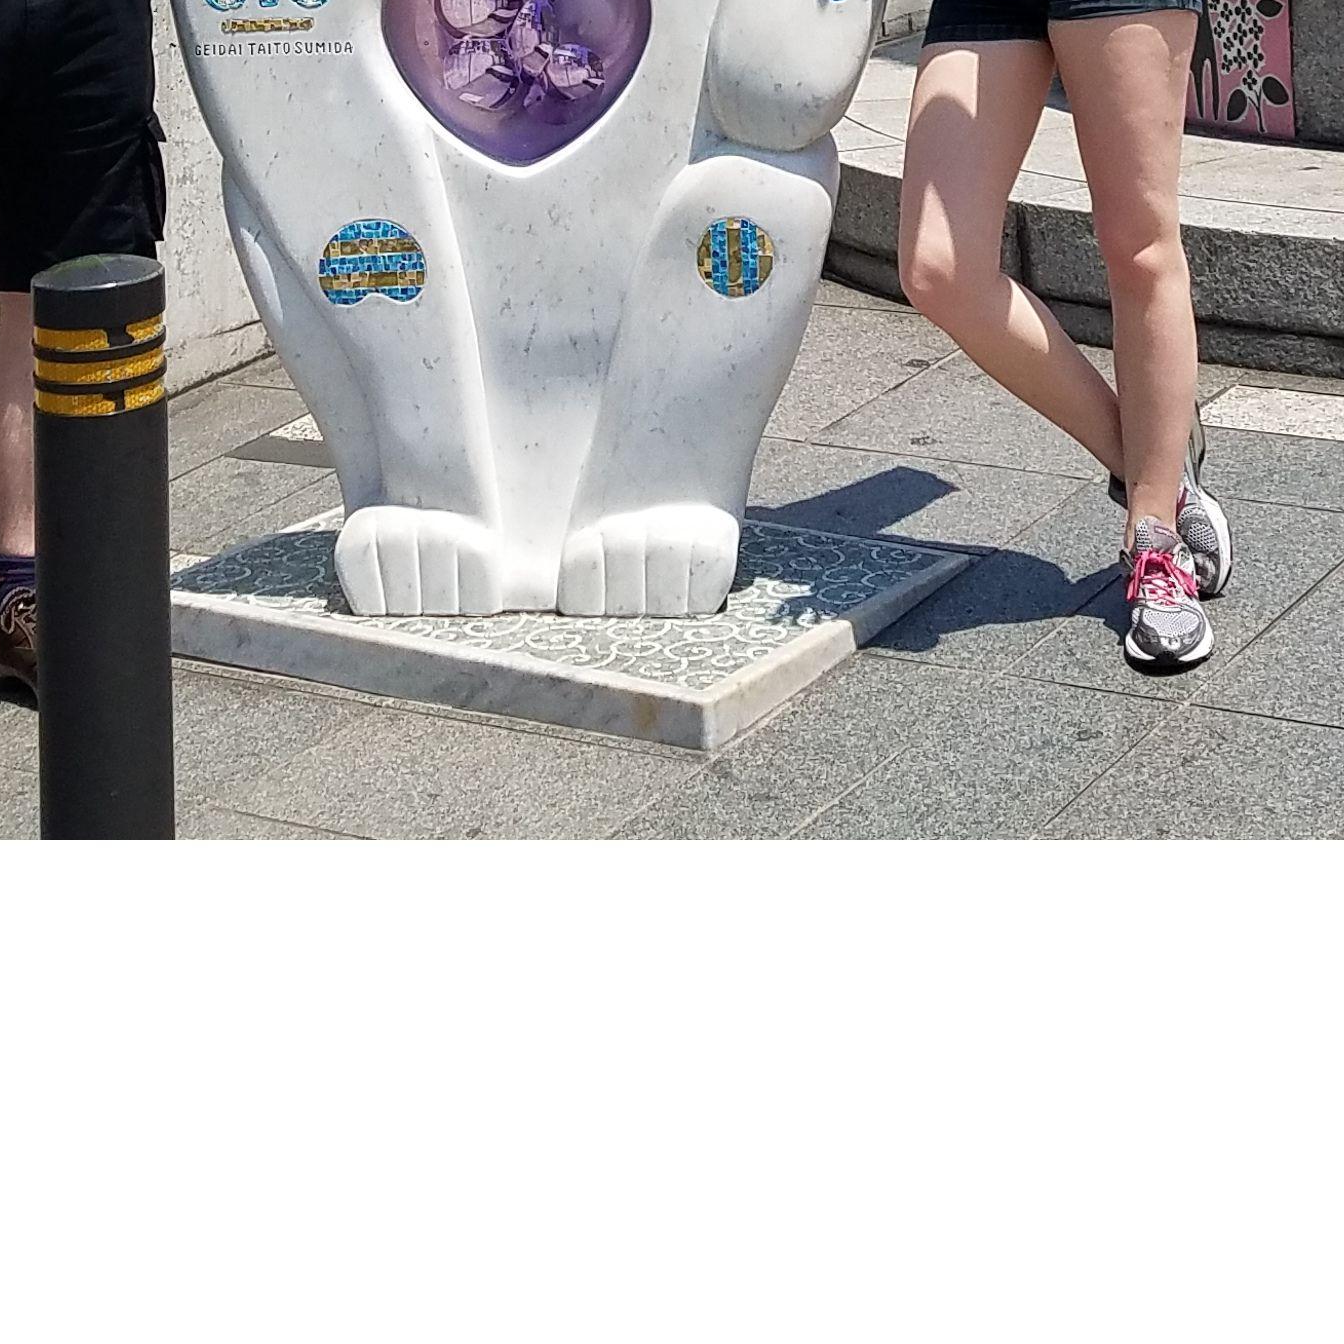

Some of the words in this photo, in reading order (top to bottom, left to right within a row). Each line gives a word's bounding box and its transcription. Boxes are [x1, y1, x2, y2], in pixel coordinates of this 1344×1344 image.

[195, 43, 243, 56] GEIDAI
[248, 42, 291, 55] TAITO
[294, 41, 354, 55] SUMIDA
